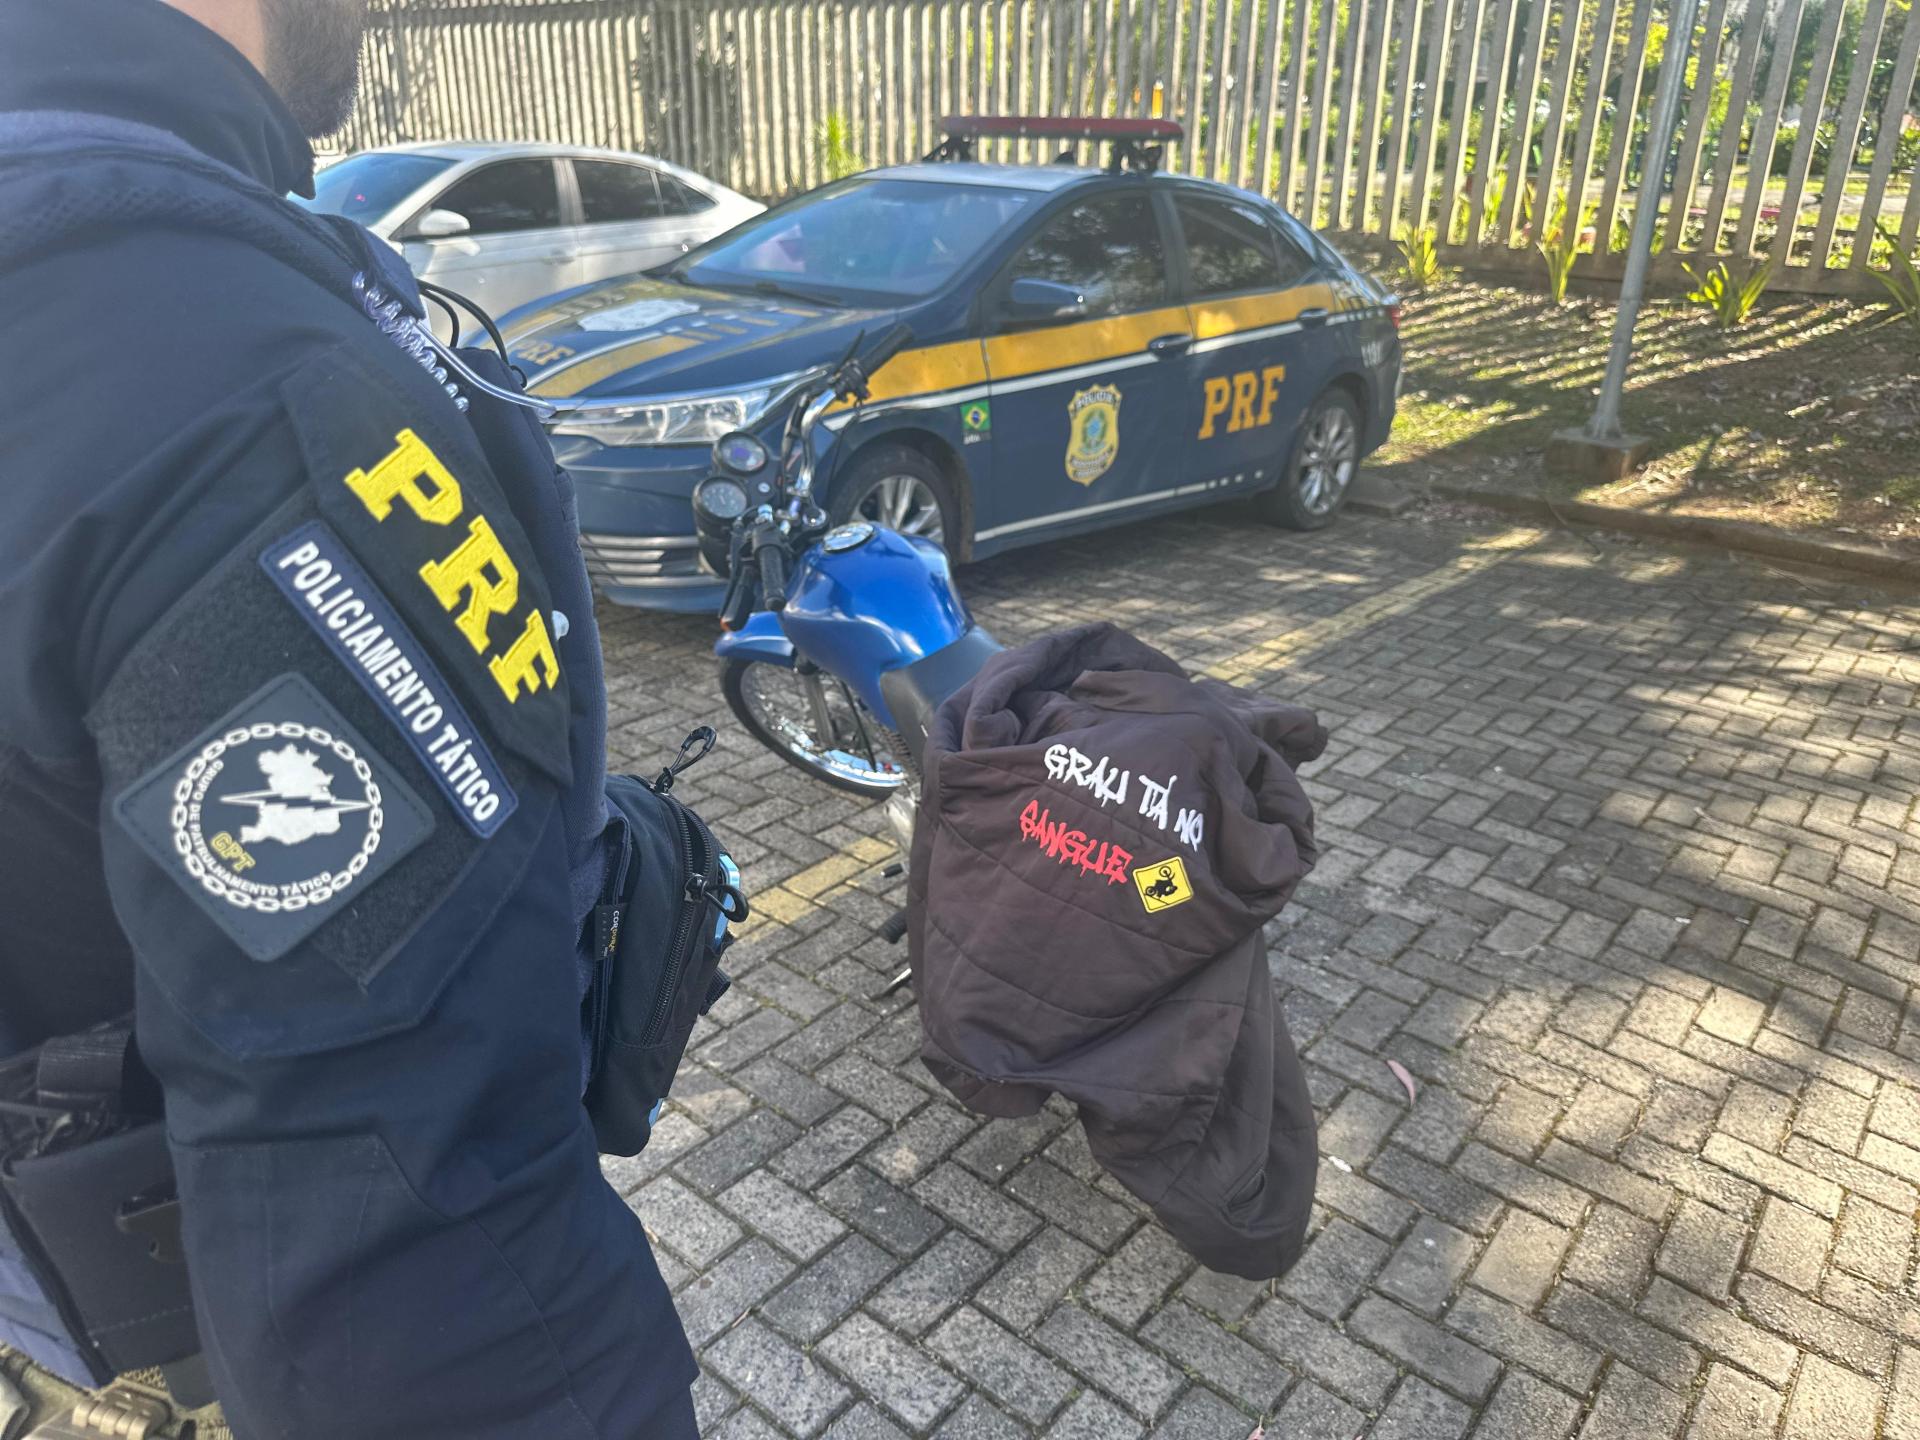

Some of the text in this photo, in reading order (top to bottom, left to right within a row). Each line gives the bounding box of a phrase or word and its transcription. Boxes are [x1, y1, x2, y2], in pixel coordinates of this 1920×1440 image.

[1198, 364, 1285, 440] PRF
[344, 427, 560, 704] PRF
[279, 541, 500, 822] POLICIAMENTO TÁTICO
[189, 760, 332, 897] GRUPO DE PATRULHAMENTO TÁTICO
[210, 831, 256, 872] GPT
[1020, 799, 1133, 886] SANGUE
[1044, 744, 1204, 852] GRAU TÁ NO
